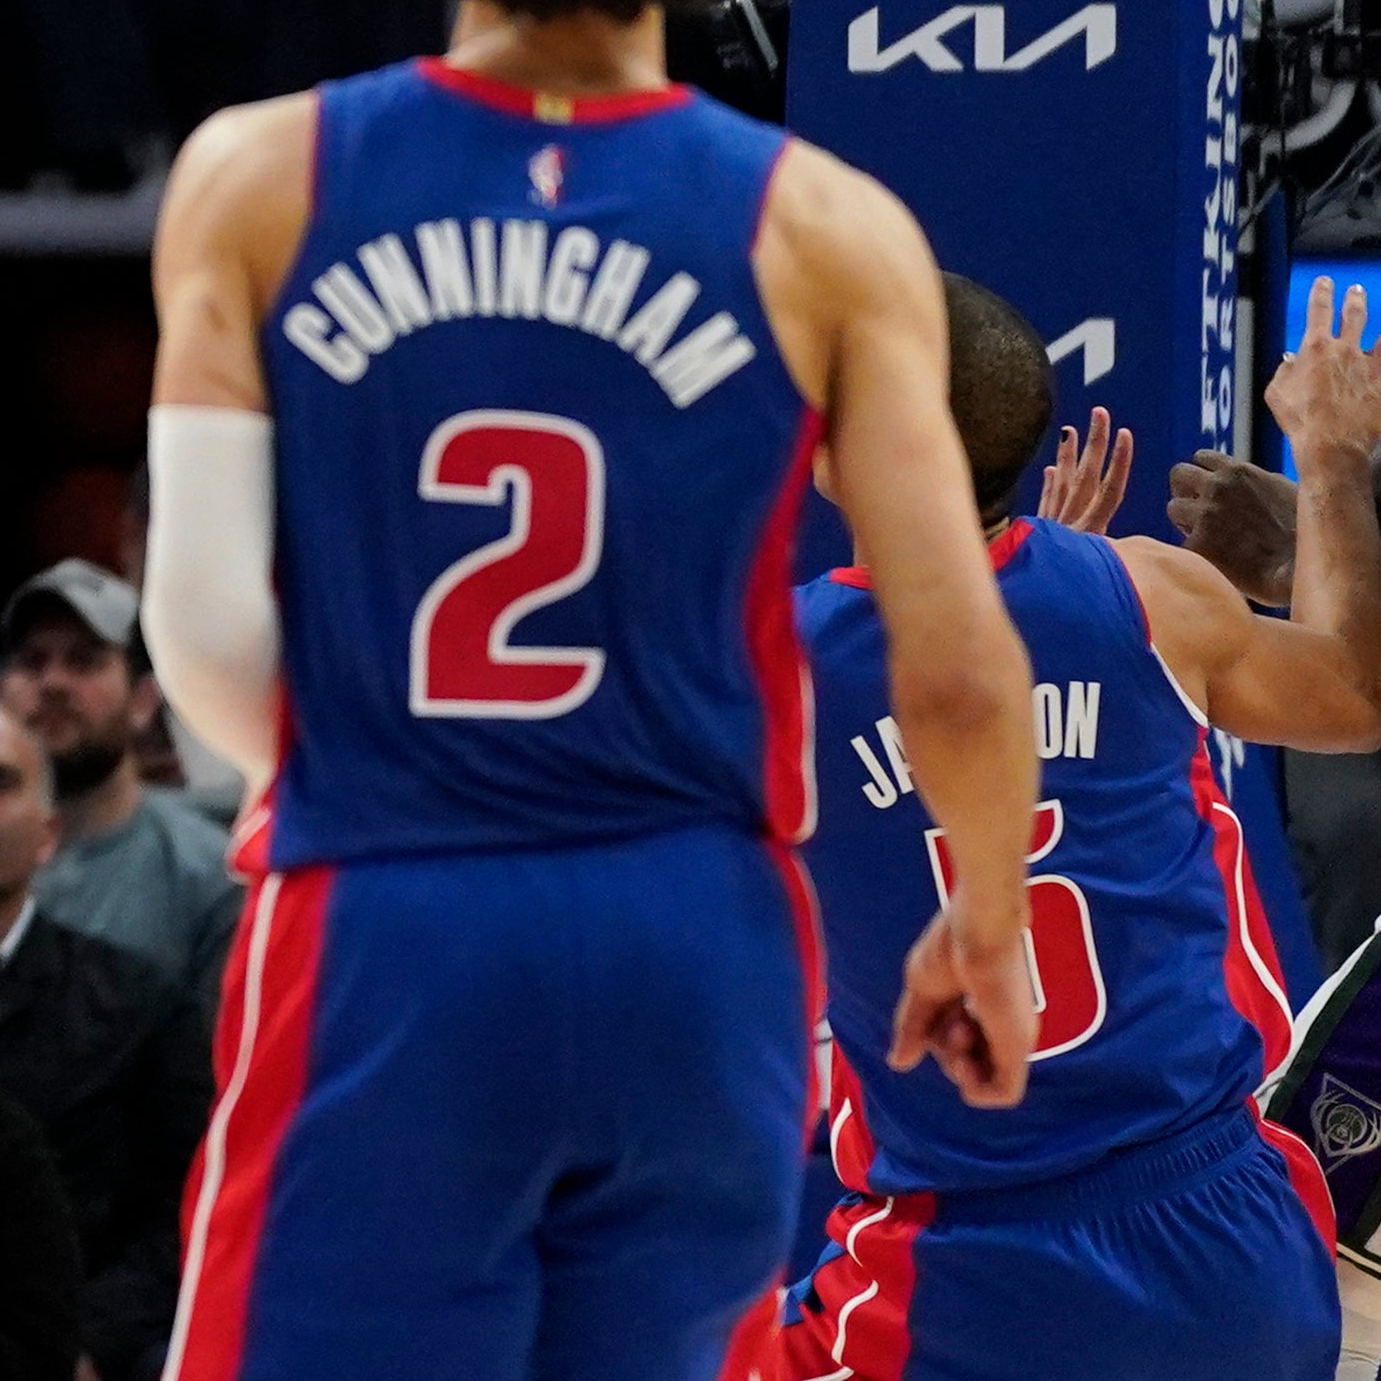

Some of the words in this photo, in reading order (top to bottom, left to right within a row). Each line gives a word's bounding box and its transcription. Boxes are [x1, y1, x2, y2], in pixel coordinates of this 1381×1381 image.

[847, 2, 1117, 73] KIA
[282, 217, 757, 410] CUNNINGHAM
[409, 408, 607, 719] 2
